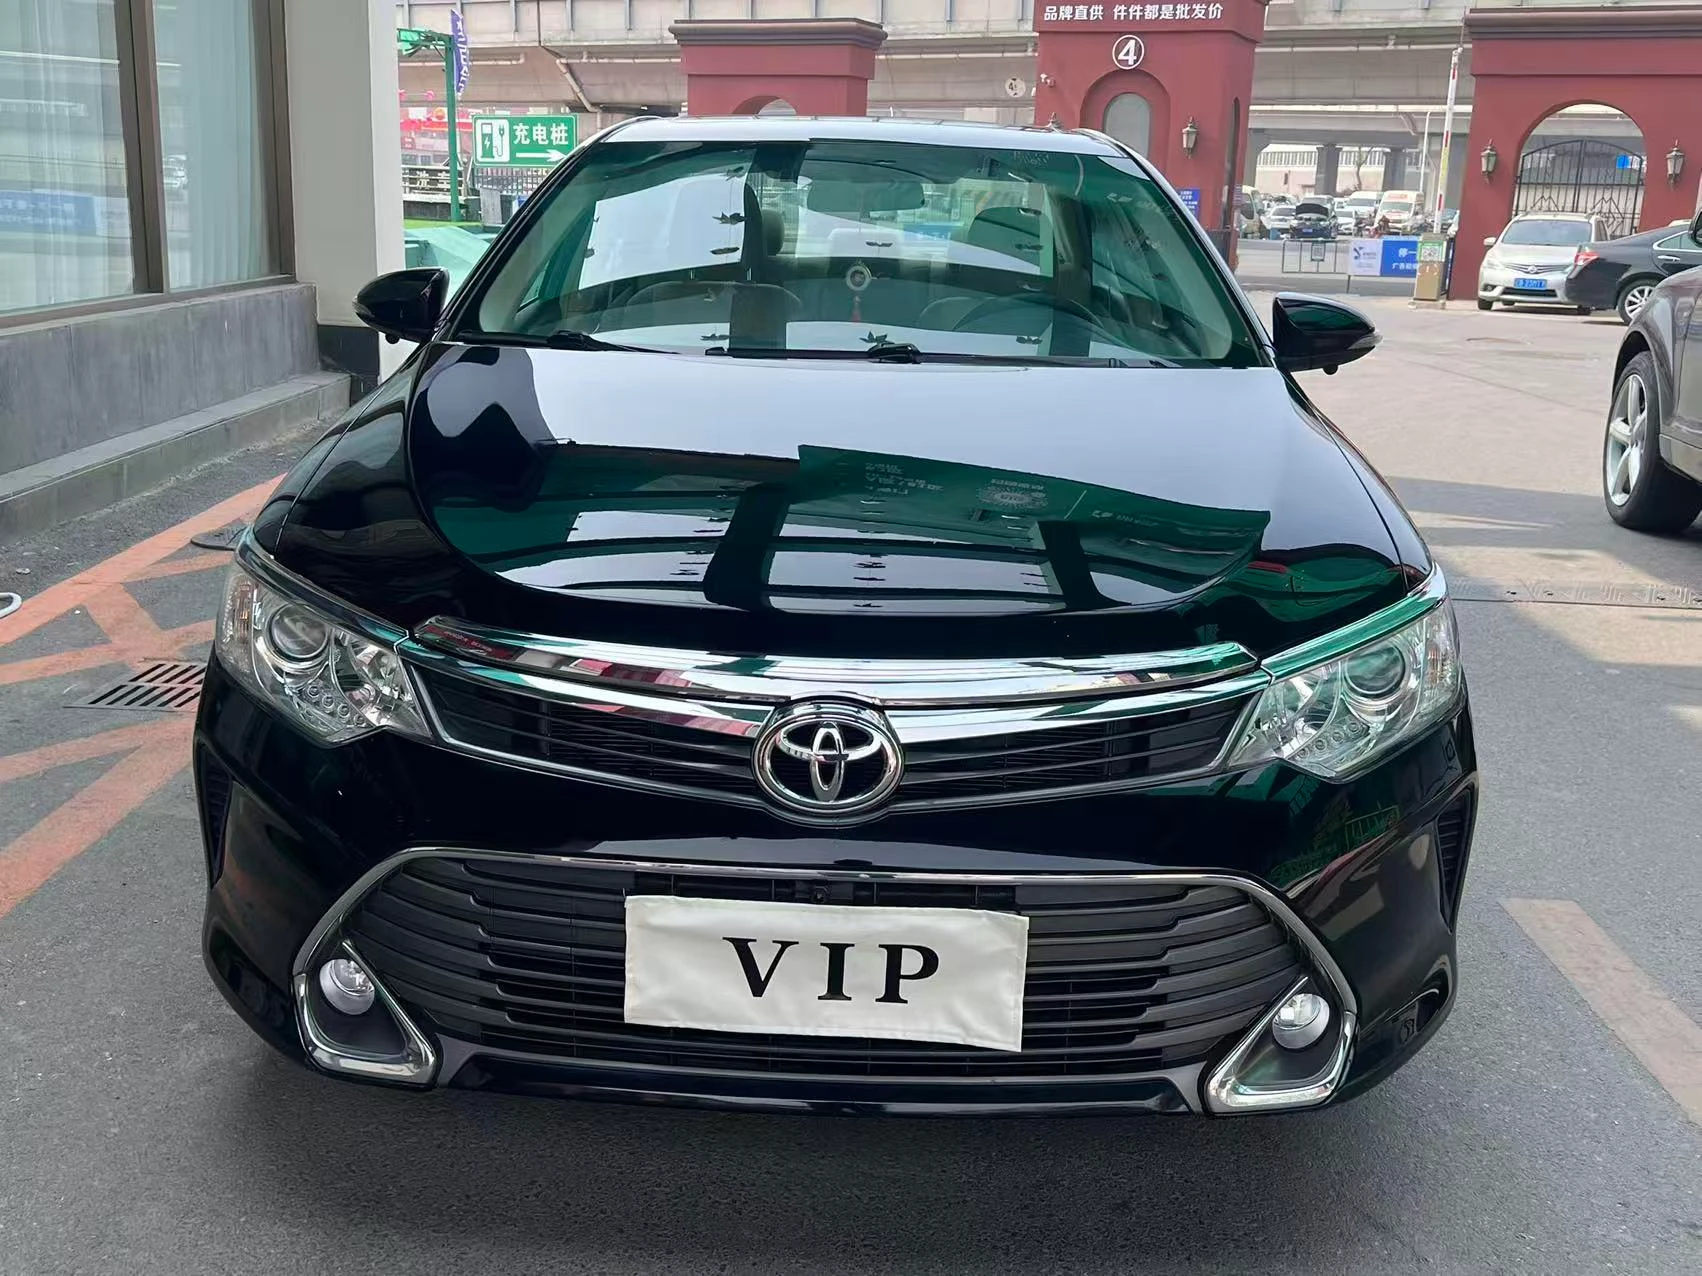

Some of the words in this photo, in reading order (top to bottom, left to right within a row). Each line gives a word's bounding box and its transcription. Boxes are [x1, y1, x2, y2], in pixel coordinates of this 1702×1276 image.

[1043, 5, 1103, 21] 品牌直供
[1113, 4, 1223, 20] 件件都是批发价
[1117, 39, 1138, 66] 4
[512, 122, 569, 146] 充电桩
[722, 936, 939, 1004] VIP
